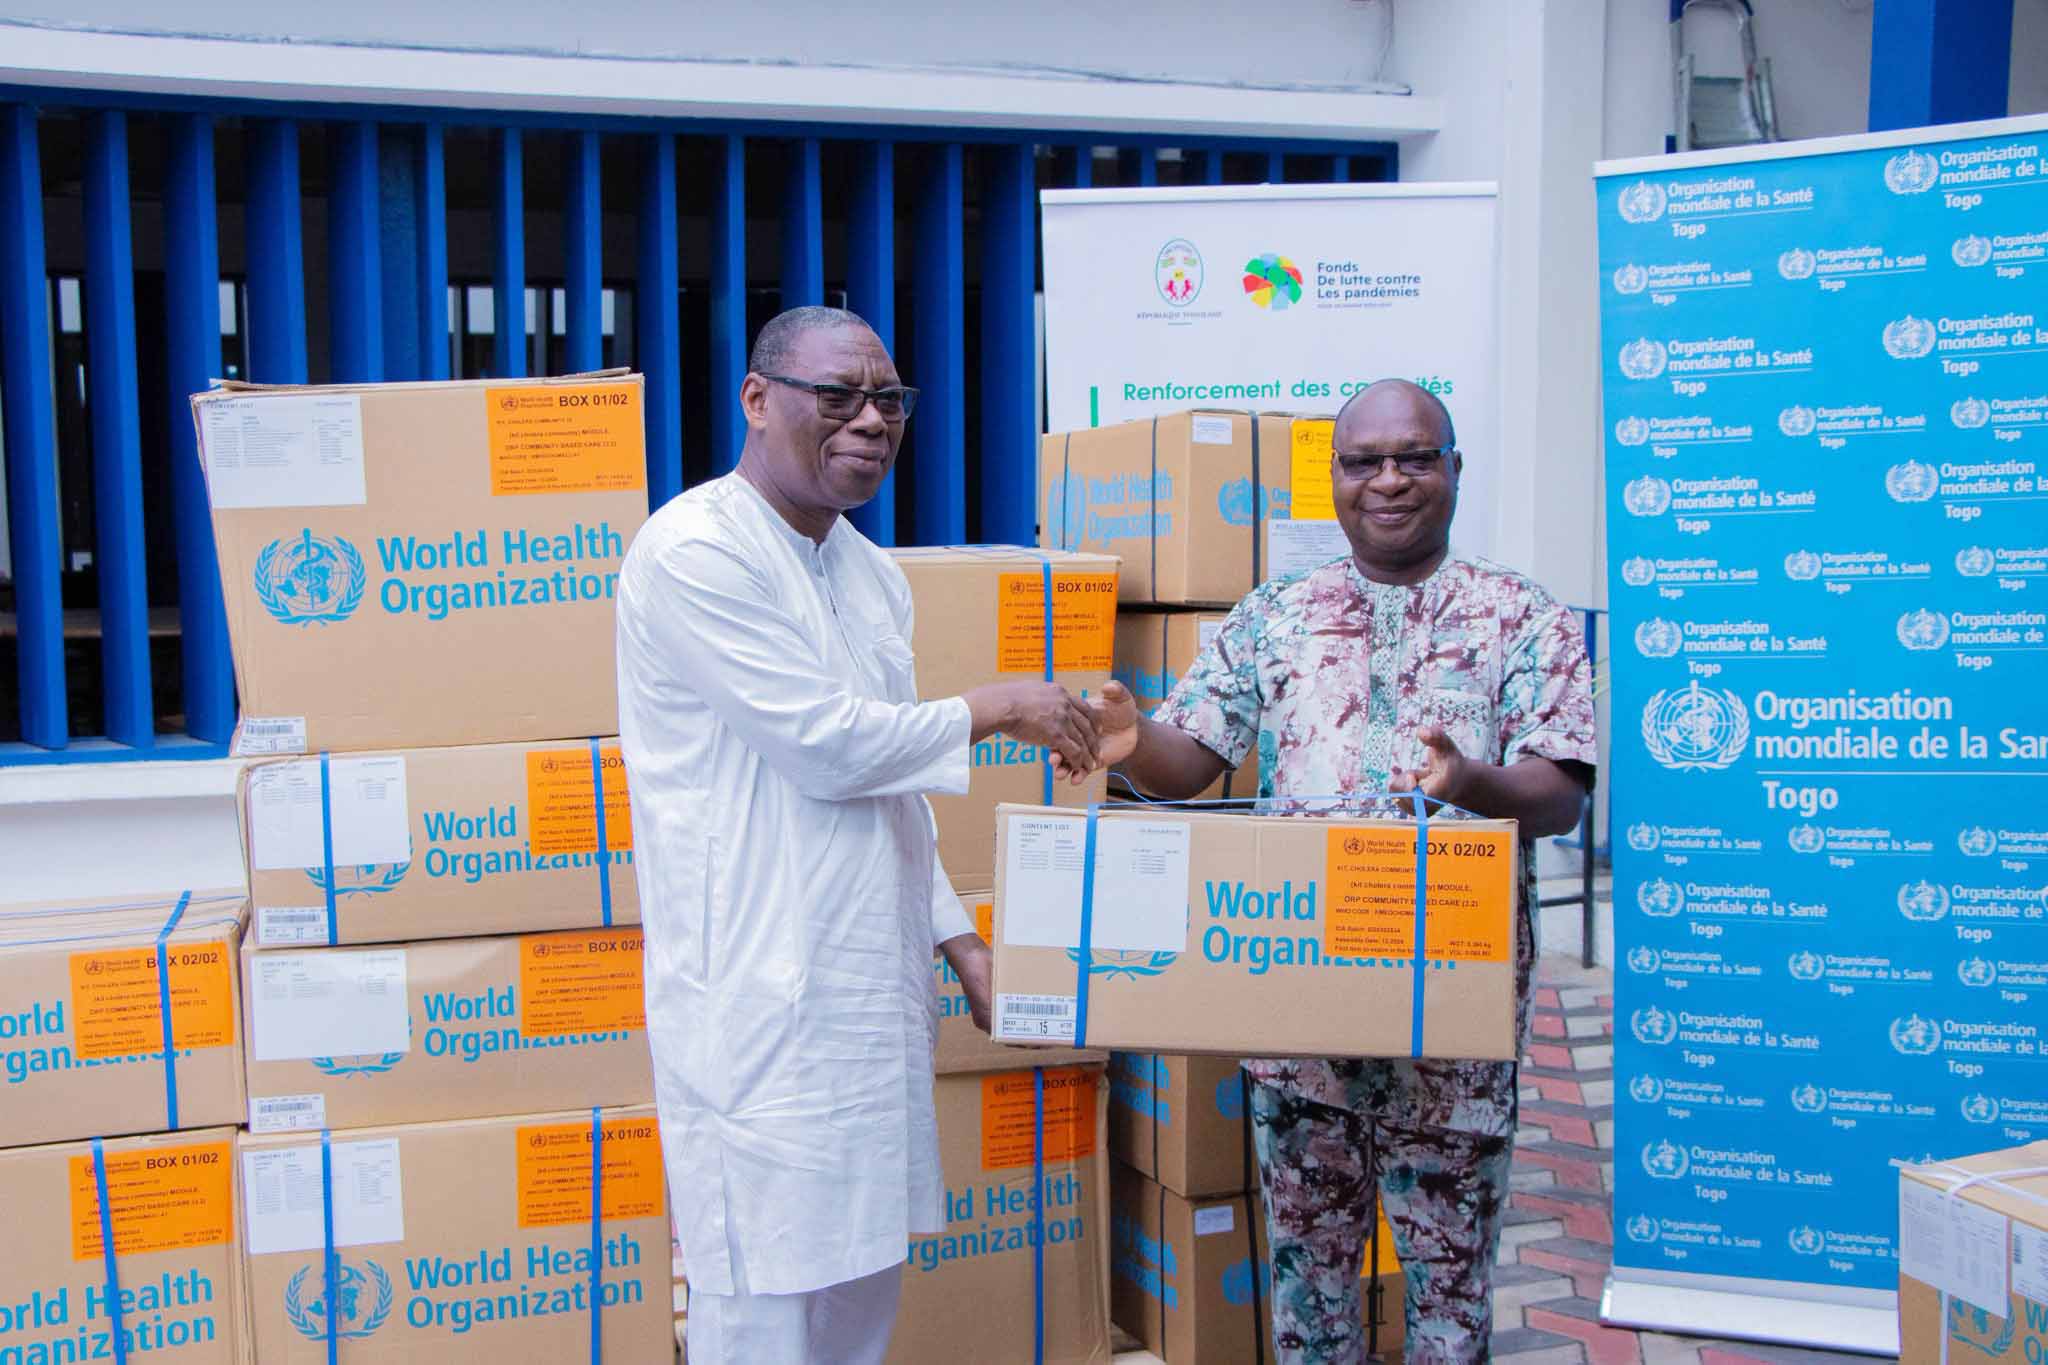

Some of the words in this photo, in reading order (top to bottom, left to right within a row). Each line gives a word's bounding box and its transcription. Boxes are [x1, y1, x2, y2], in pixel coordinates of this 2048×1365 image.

[1940, 144, 2038, 169] Organisation
[1940, 156, 2012, 186] mondiale
[2016, 160, 2036, 176] de
[1668, 176, 1756, 199] Organisation
[1668, 192, 1731, 214] mondiale
[1734, 192, 1752, 208] de
[1756, 192, 1770, 206] la
[1773, 187, 1813, 205] Santé
[1944, 193, 1982, 210] Togo
[1672, 222, 1706, 238] Togo
[1317, 261, 1359, 273] Fonds
[1317, 275, 1336, 286] De
[1340, 274, 1372, 286] lutte
[1376, 274, 1422, 285] contre
[1318, 288, 1340, 299] Les
[1344, 285, 1420, 300] pandémies
[1938, 313, 2034, 336] Organisation
[1668, 336, 1754, 359] Organisation
[1938, 328, 2008, 350] mondiale
[2012, 330, 2031, 345] de
[1668, 352, 1731, 371] mondiale
[1734, 352, 1753, 368] de
[1756, 351, 1770, 366] la
[1772, 348, 1812, 366] Santé
[1942, 357, 1979, 376] Togo
[1124, 382, 1281, 401] Renforcement
[1291, 379, 1330, 398] des
[1672, 380, 1706, 396] Togo
[559, 396, 589, 407] BOX
[593, 393, 628, 406] 01/02
[1940, 460, 2035, 481] Organisation
[1672, 476, 1758, 496] Organisation
[1940, 478, 2009, 495] mondiale
[2014, 476, 2032, 492] de
[1672, 490, 1735, 509] mondiale
[1738, 492, 1756, 507] de
[1760, 491, 1773, 506] la
[1776, 490, 1816, 506] Santé
[1944, 504, 1982, 522] Togo
[1676, 518, 1710, 534] Togo
[376, 529, 486, 572] World
[503, 522, 622, 564] Health
[1057, 582, 1082, 592] BOX
[1085, 582, 1113, 592] 01/02
[1684, 620, 1769, 639] Organisation
[1952, 610, 2046, 631] Organisation
[1684, 637, 1746, 652] mondiale
[1750, 636, 1767, 651] de
[1771, 636, 1784, 651] la
[1788, 636, 1827, 650] Santé
[1952, 628, 2020, 643] mondiale
[2024, 628, 2044, 642] de
[1688, 660, 1722, 678] Togo
[1956, 653, 1992, 670] Togo
[1755, 688, 1952, 730] Organisation
[1756, 724, 1898, 758] mondiale
[1909, 726, 1948, 758] de
[1960, 726, 1988, 758] la
[1763, 780, 1838, 817] Togo
[423, 806, 516, 842] World
[1454, 843, 1496, 856] 02/02
[1205, 880, 1316, 920] World
[1344, 895, 1361, 904] ORP
[1362, 896, 1410, 905] COMMUNITY
[1686, 882, 1770, 903] Organisation
[1686, 898, 1748, 917] mondiale
[1752, 901, 1768, 915] de
[1772, 902, 1784, 916] la
[1788, 902, 1828, 917] Santé
[1952, 902, 2020, 917] mondiale
[2024, 904, 2043, 918] de
[1690, 922, 1722, 938] Togo
[1956, 926, 1992, 943] Togo
[588, 942, 617, 953] BOX
[146, 956, 178, 969] BX
[182, 952, 218, 965] 02/02
[424, 985, 516, 1023] World
[0, 999, 64, 1038] orld
[1680, 1012, 1763, 1033] Organisation
[1680, 1030, 1740, 1044] mondiale
[1744, 1032, 1760, 1045] de
[1765, 1032, 1777, 1046] la
[1781, 1034, 1820, 1048] Santé
[1944, 1020, 2036, 1042] Organisation
[1944, 1038, 2011, 1055] mondiale
[2016, 1040, 2034, 1056] de
[1683, 1050, 1715, 1068] Togo
[1948, 1060, 1984, 1078] Togo
[618, 1127, 652, 1140] 01/02
[146, 1158, 178, 1170] BOX
[182, 1152, 218, 1164] 01/02
[1691, 1146, 1775, 1168] Organisation
[1691, 1164, 1752, 1180] mondiale
[1756, 1168, 1773, 1180] de
[1778, 1168, 1790, 1182] la
[1794, 1170, 1832, 1185] Santé
[1696, 1184, 1728, 1202] Togo
[405, 1248, 511, 1290] World
[527, 1232, 641, 1279] Heath
[0, 1287, 68, 1333] orld
